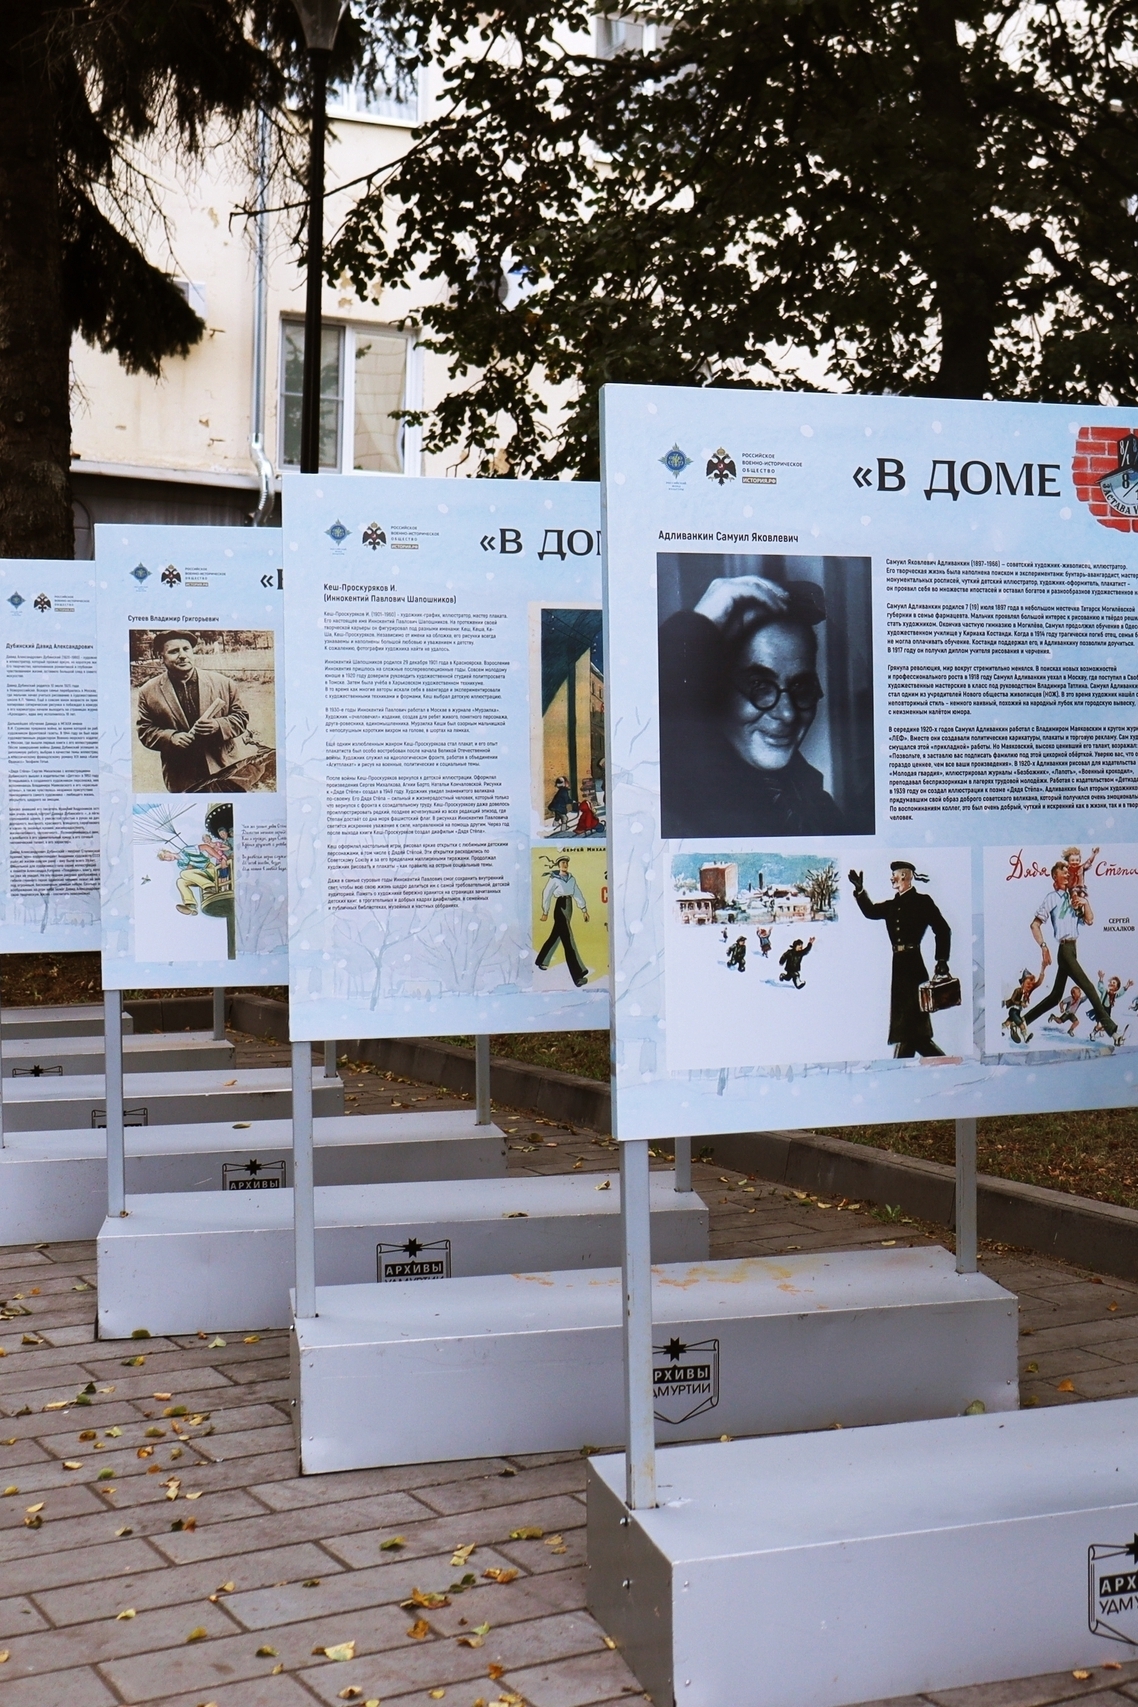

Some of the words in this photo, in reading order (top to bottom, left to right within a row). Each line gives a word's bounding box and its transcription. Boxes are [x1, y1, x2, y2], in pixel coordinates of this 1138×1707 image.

[854, 458, 906, 492] «В
[925, 460, 1062, 501] ДОМЕ
[1103, 483, 1130, 514] ЗАСТАВА
[658, 531, 714, 541] Адливанкин
[716, 532, 749, 543] Самуил
[752, 532, 799, 543] Яковлевич
[480, 528, 522, 554] «В
[538, 529, 601, 561] ДО
[324, 584, 389, 593] Кеш-Проскуряков
[324, 594, 369, 602] (Иннокентий
[407, 596, 457, 604] Шапошников)
[1006, 849, 1050, 881] Дядя
[230, 1180, 278, 1190] АРХИВЫ
[386, 1263, 442, 1276] АРХИВЫ
[654, 1368, 708, 1382] РХИВЫ
[653, 1383, 710, 1398] МУРТИИ
